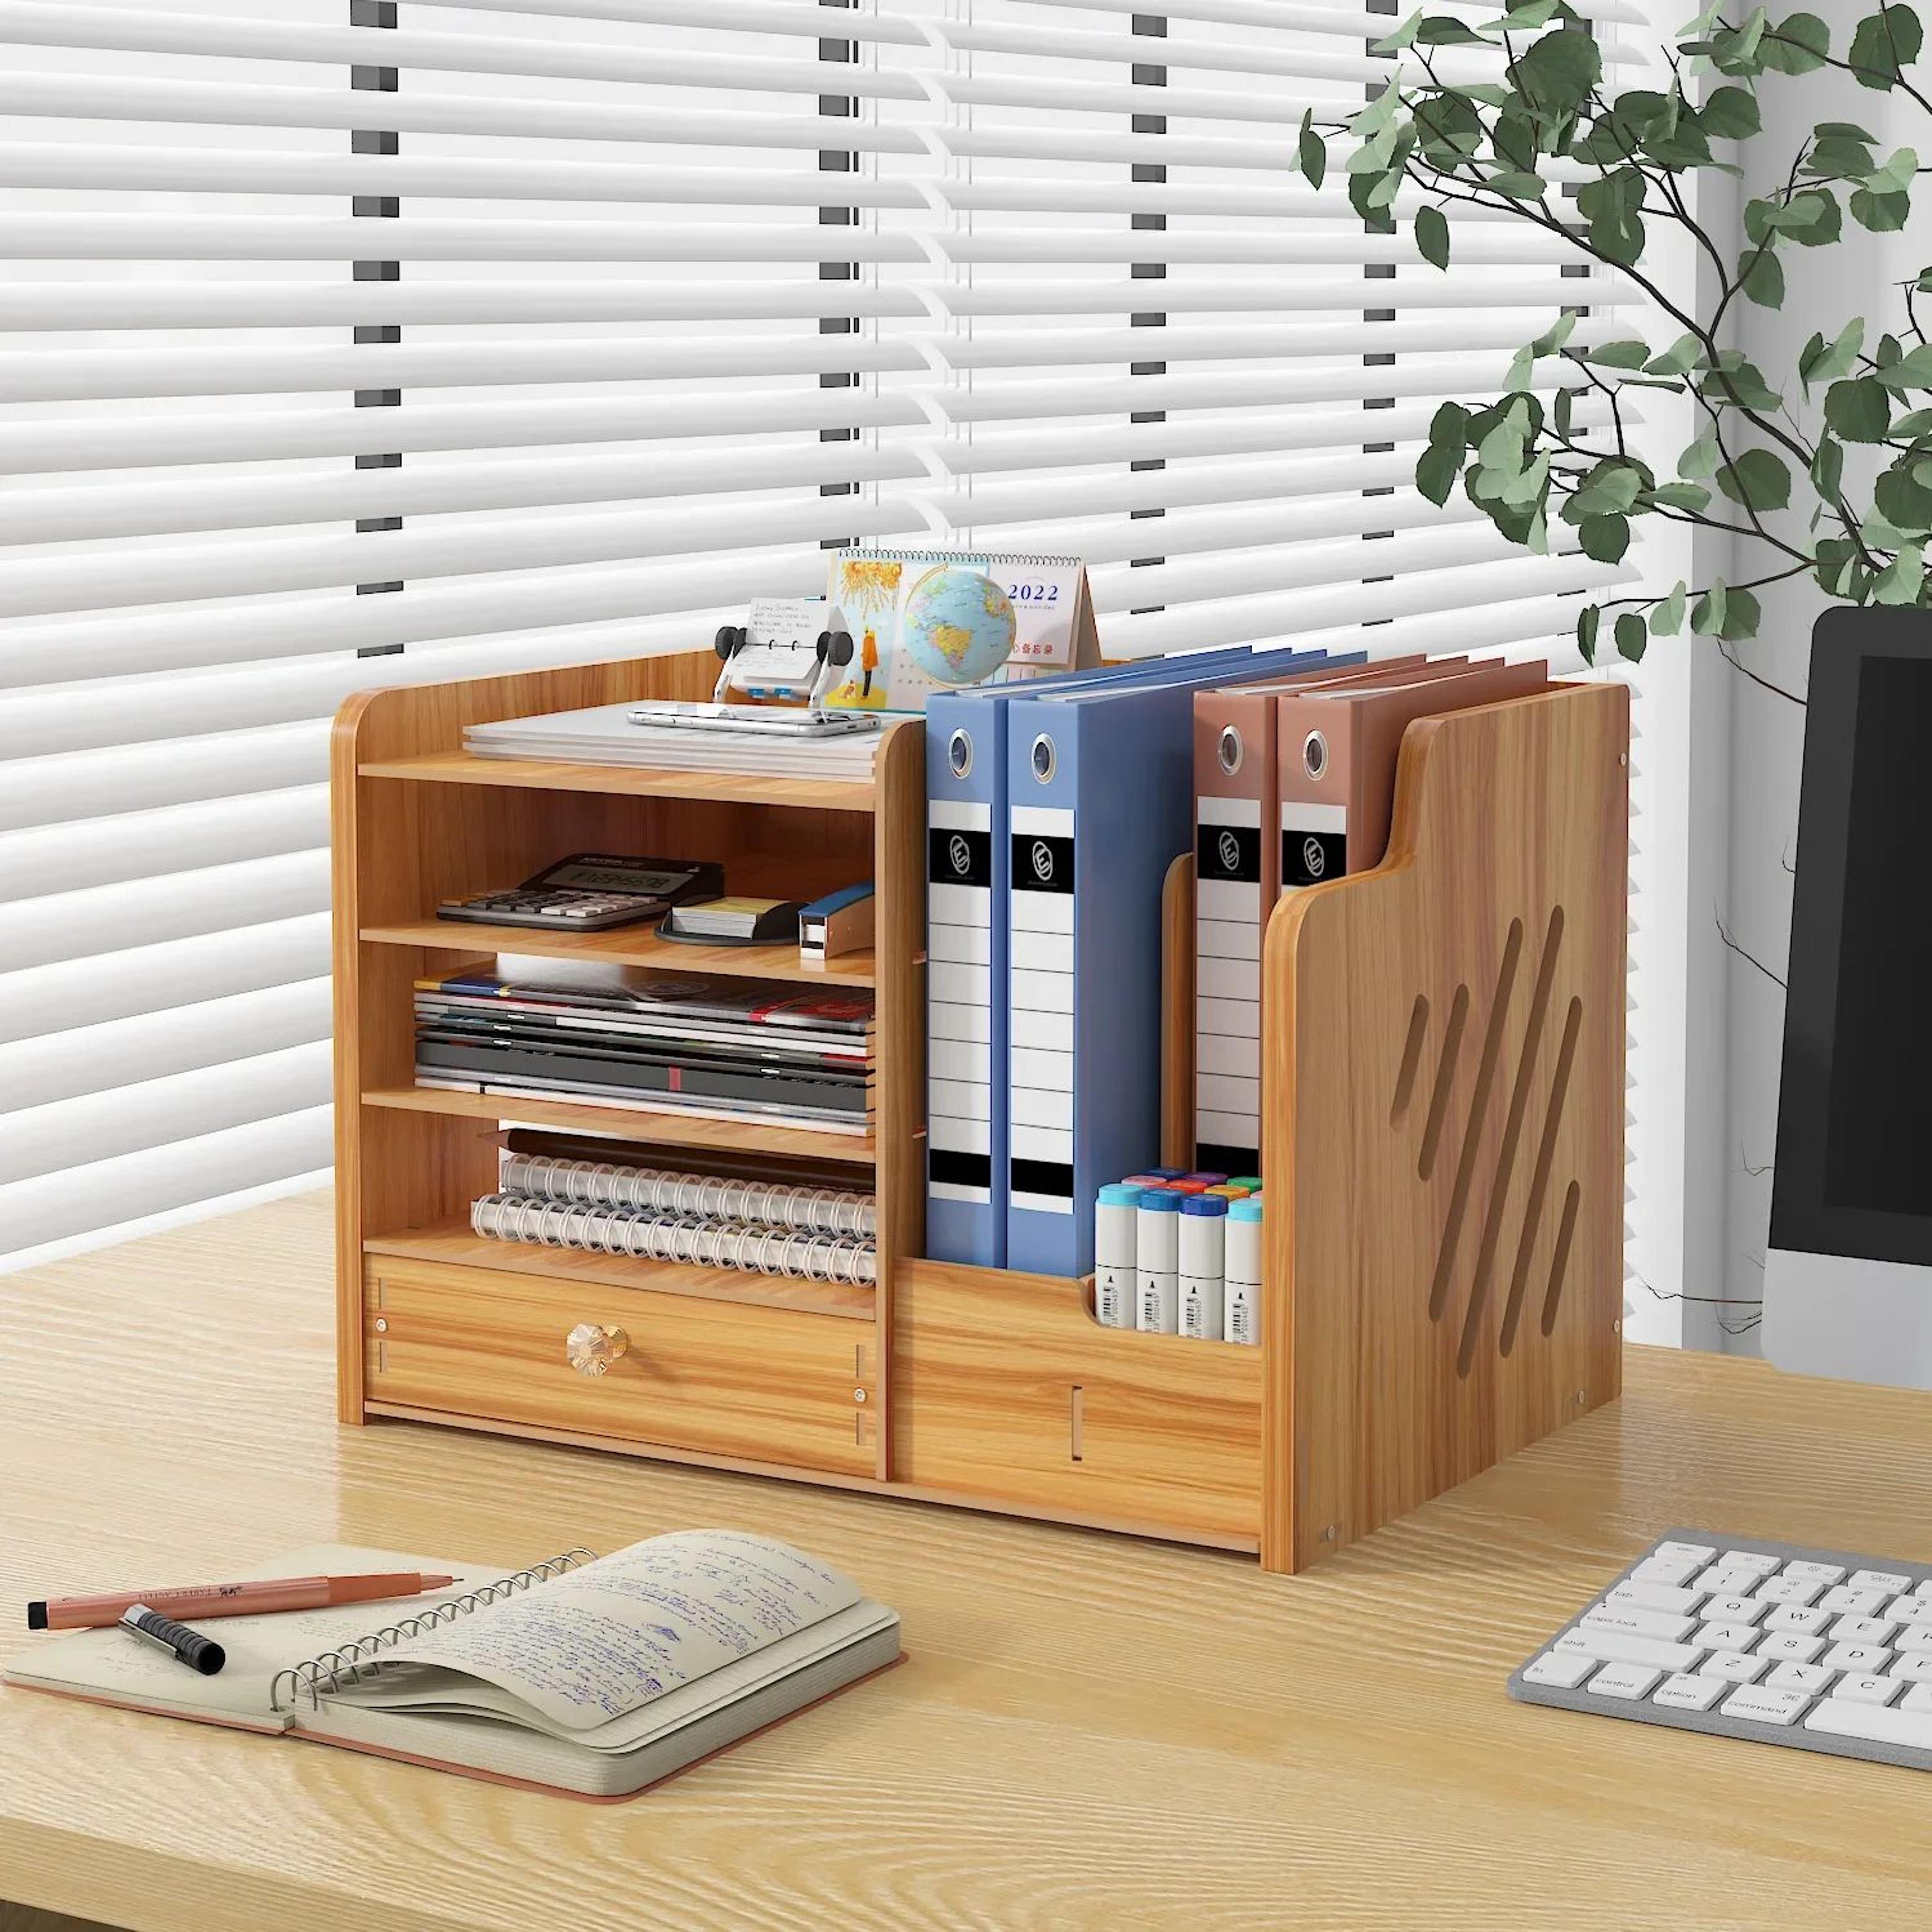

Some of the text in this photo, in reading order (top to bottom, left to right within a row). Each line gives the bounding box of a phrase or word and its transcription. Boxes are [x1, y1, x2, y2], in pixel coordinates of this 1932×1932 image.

[1008, 584, 1058, 601] 2022
[1791, 1612, 1809, 1620] W
[1857, 1623, 1872, 1631] E
[1715, 1630, 1729, 1638] A
[1563, 1639, 1586, 1648] shift
[1792, 1670, 1808, 1678] X
[1595, 1678, 1635, 1688] control
[1661, 1690, 1696, 1699] option
[1728, 1700, 1788, 1715] command
